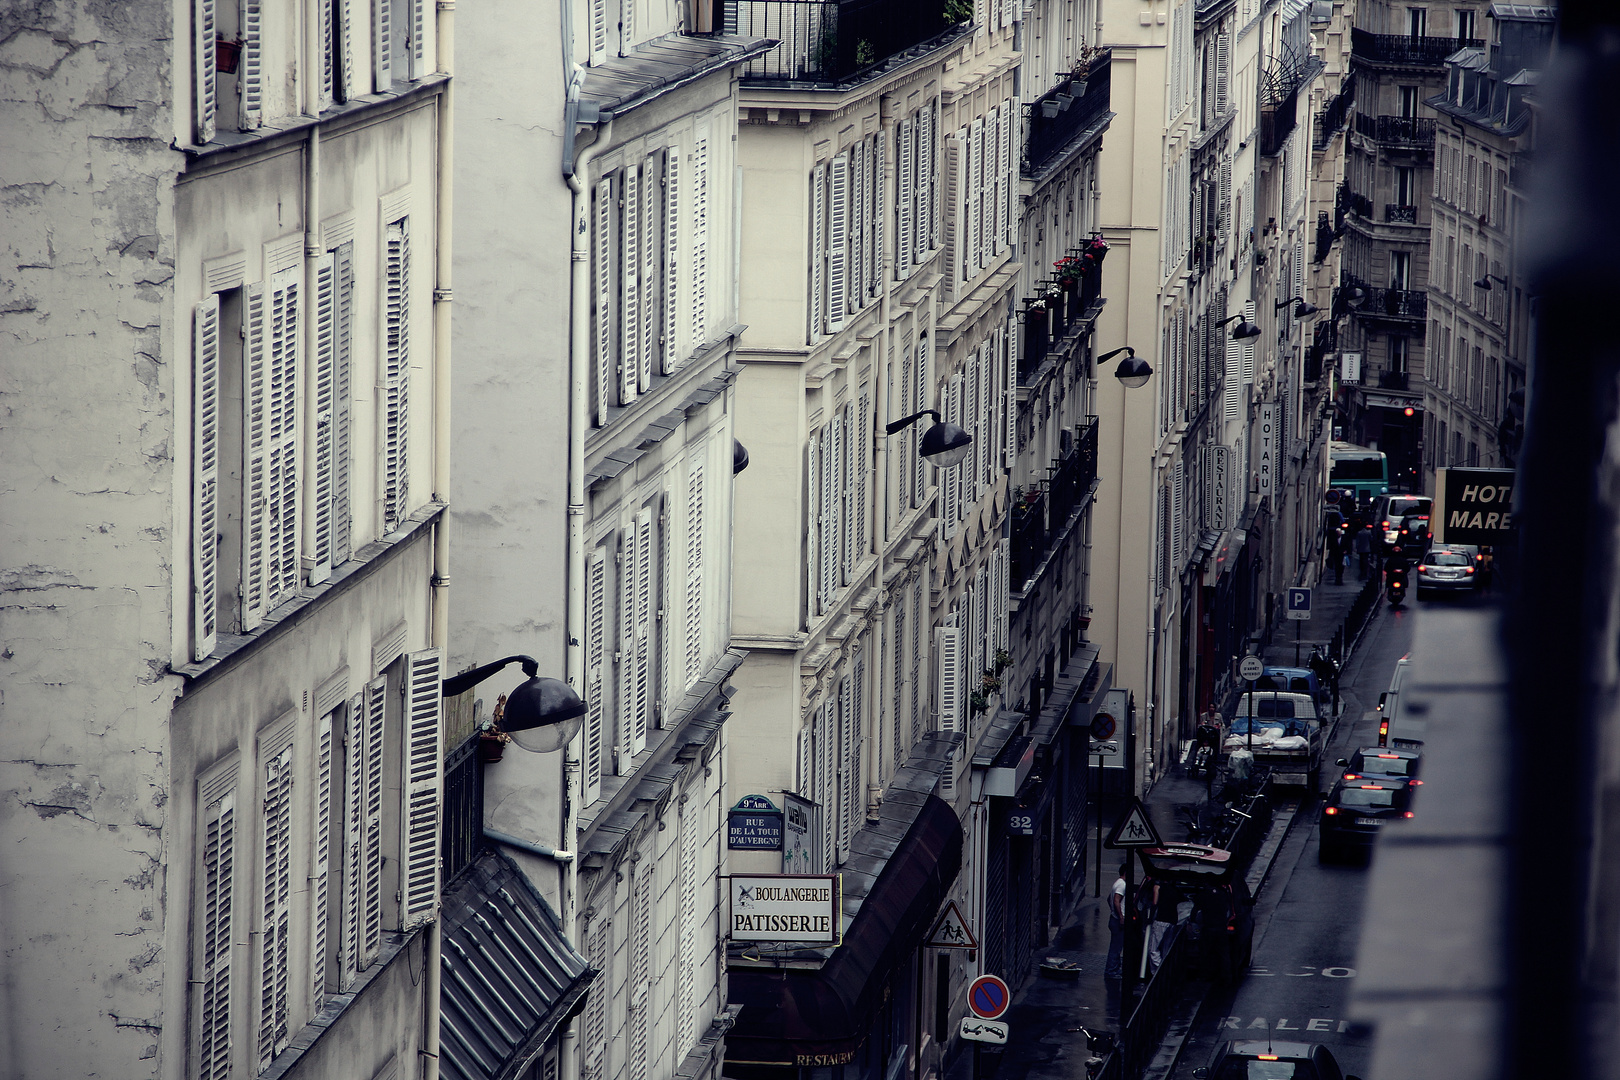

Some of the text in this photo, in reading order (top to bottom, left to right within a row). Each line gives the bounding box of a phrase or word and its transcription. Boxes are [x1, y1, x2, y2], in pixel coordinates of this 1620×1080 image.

[1261, 410, 1271, 489] HOTARU
[1216, 449, 1225, 528] RESTAURANT
[1449, 510, 1517, 530] MARE
[1294, 592, 1305, 606] P
[745, 818, 765, 827] RUE
[1010, 816, 1032, 828] 32
[730, 827, 779, 836] DE LA TOUR
[730, 836, 780, 845] D'AUVERGNE
[755, 887, 829, 902] BOULANGERIE
[734, 914, 829, 932] PATISSERIE
